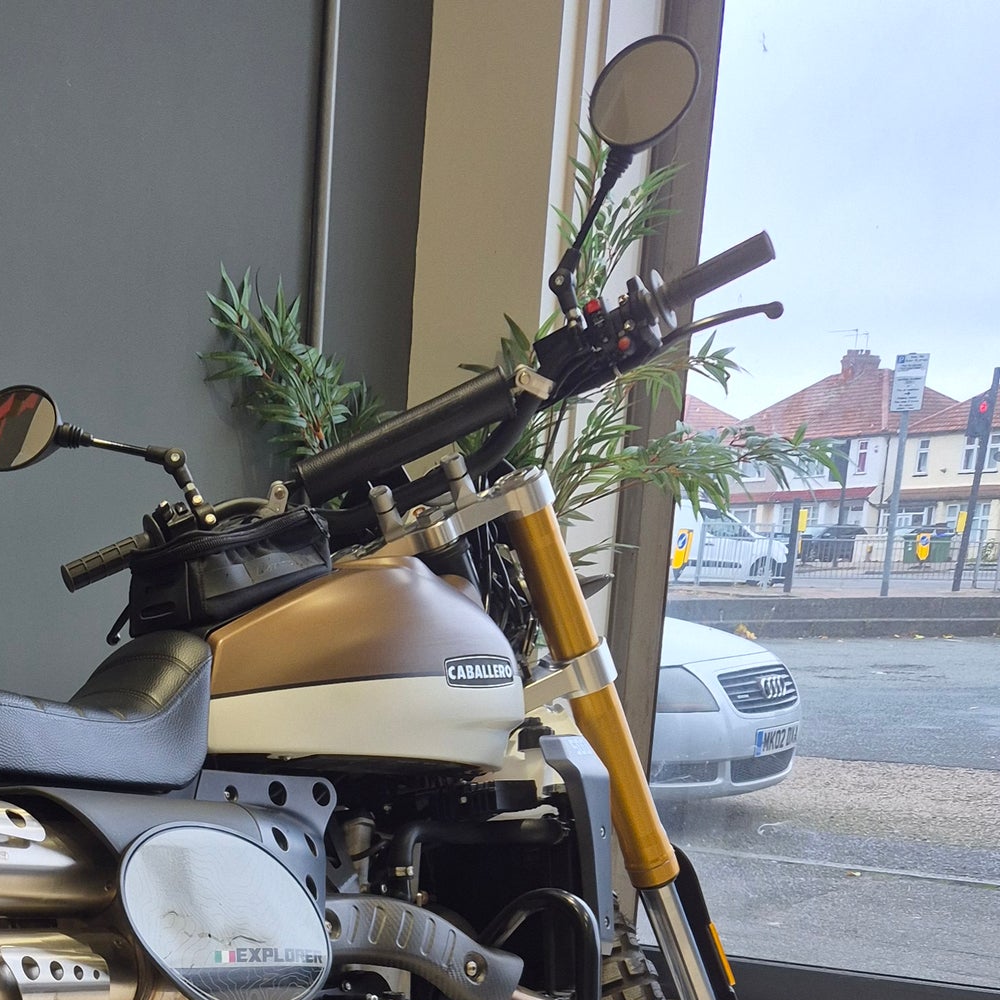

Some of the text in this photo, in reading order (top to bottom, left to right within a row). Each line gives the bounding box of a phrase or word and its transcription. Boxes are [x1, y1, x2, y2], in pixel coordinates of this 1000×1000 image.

[448, 664, 513, 680] CABALLERO
[762, 728, 787, 752] MK02
[235, 947, 323, 964] EXPLORER
